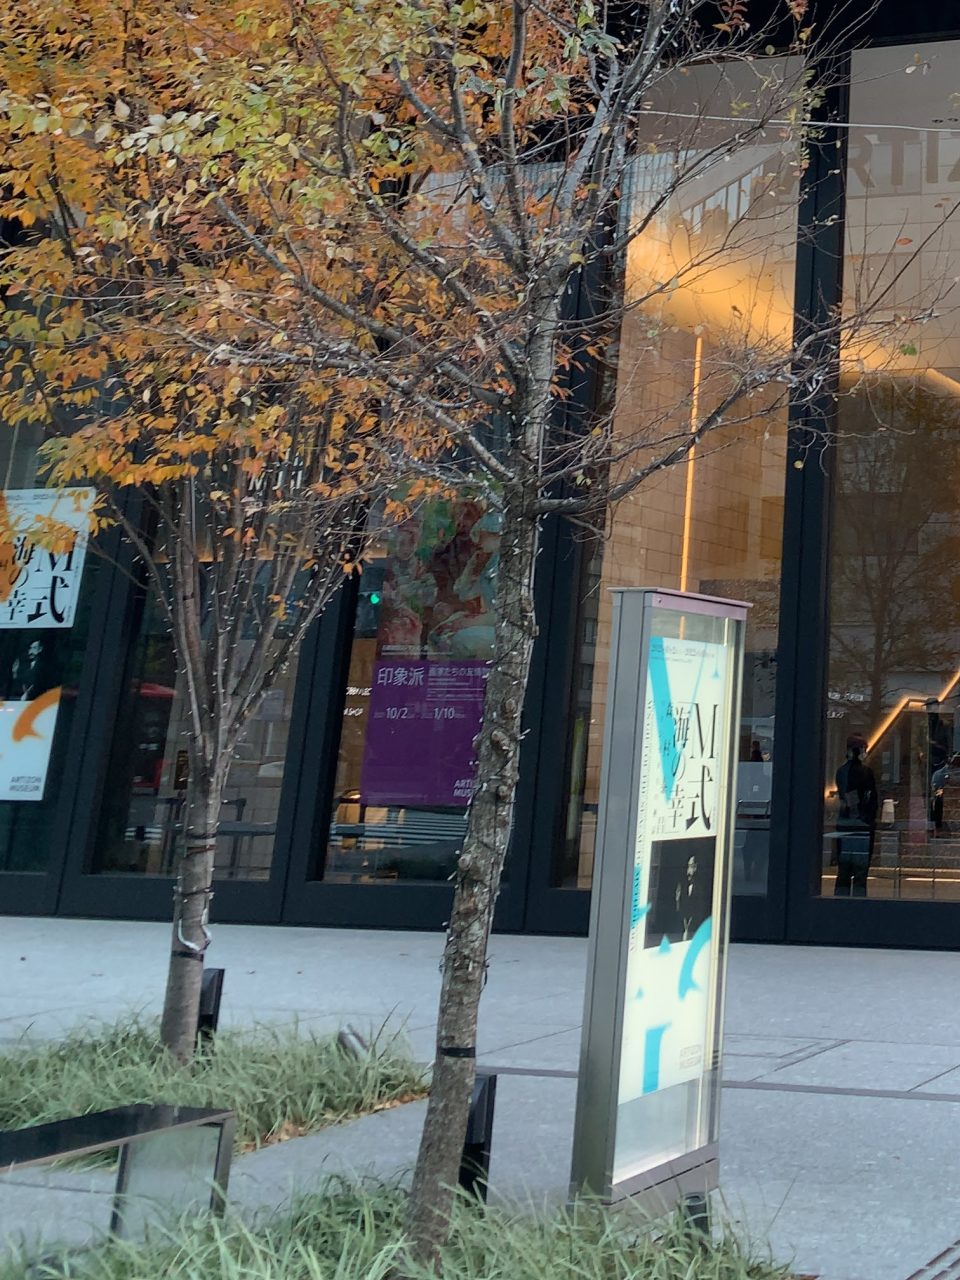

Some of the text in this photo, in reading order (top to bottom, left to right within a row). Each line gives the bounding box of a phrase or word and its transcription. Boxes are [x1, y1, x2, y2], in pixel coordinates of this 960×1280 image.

[377, 666, 425, 686] 印象派
[685, 702, 719, 831] M式
